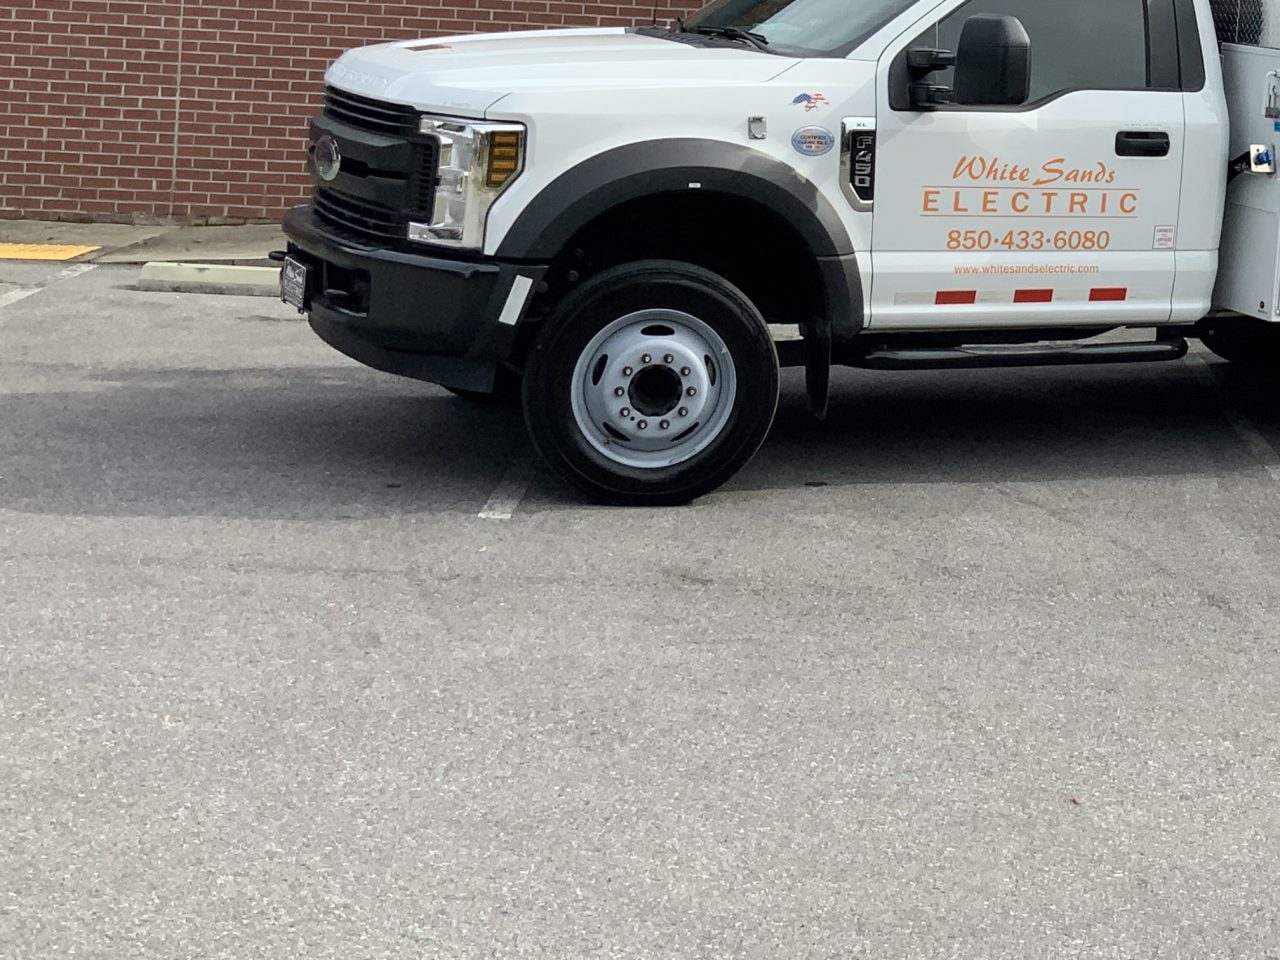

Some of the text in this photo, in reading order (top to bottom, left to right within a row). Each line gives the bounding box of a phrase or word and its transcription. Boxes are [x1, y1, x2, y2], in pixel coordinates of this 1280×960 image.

[952, 155, 1115, 186] White Sands
[922, 190, 1137, 214] ELECTRIC
[954, 263, 1099, 275] www.whitesandselectric.com
